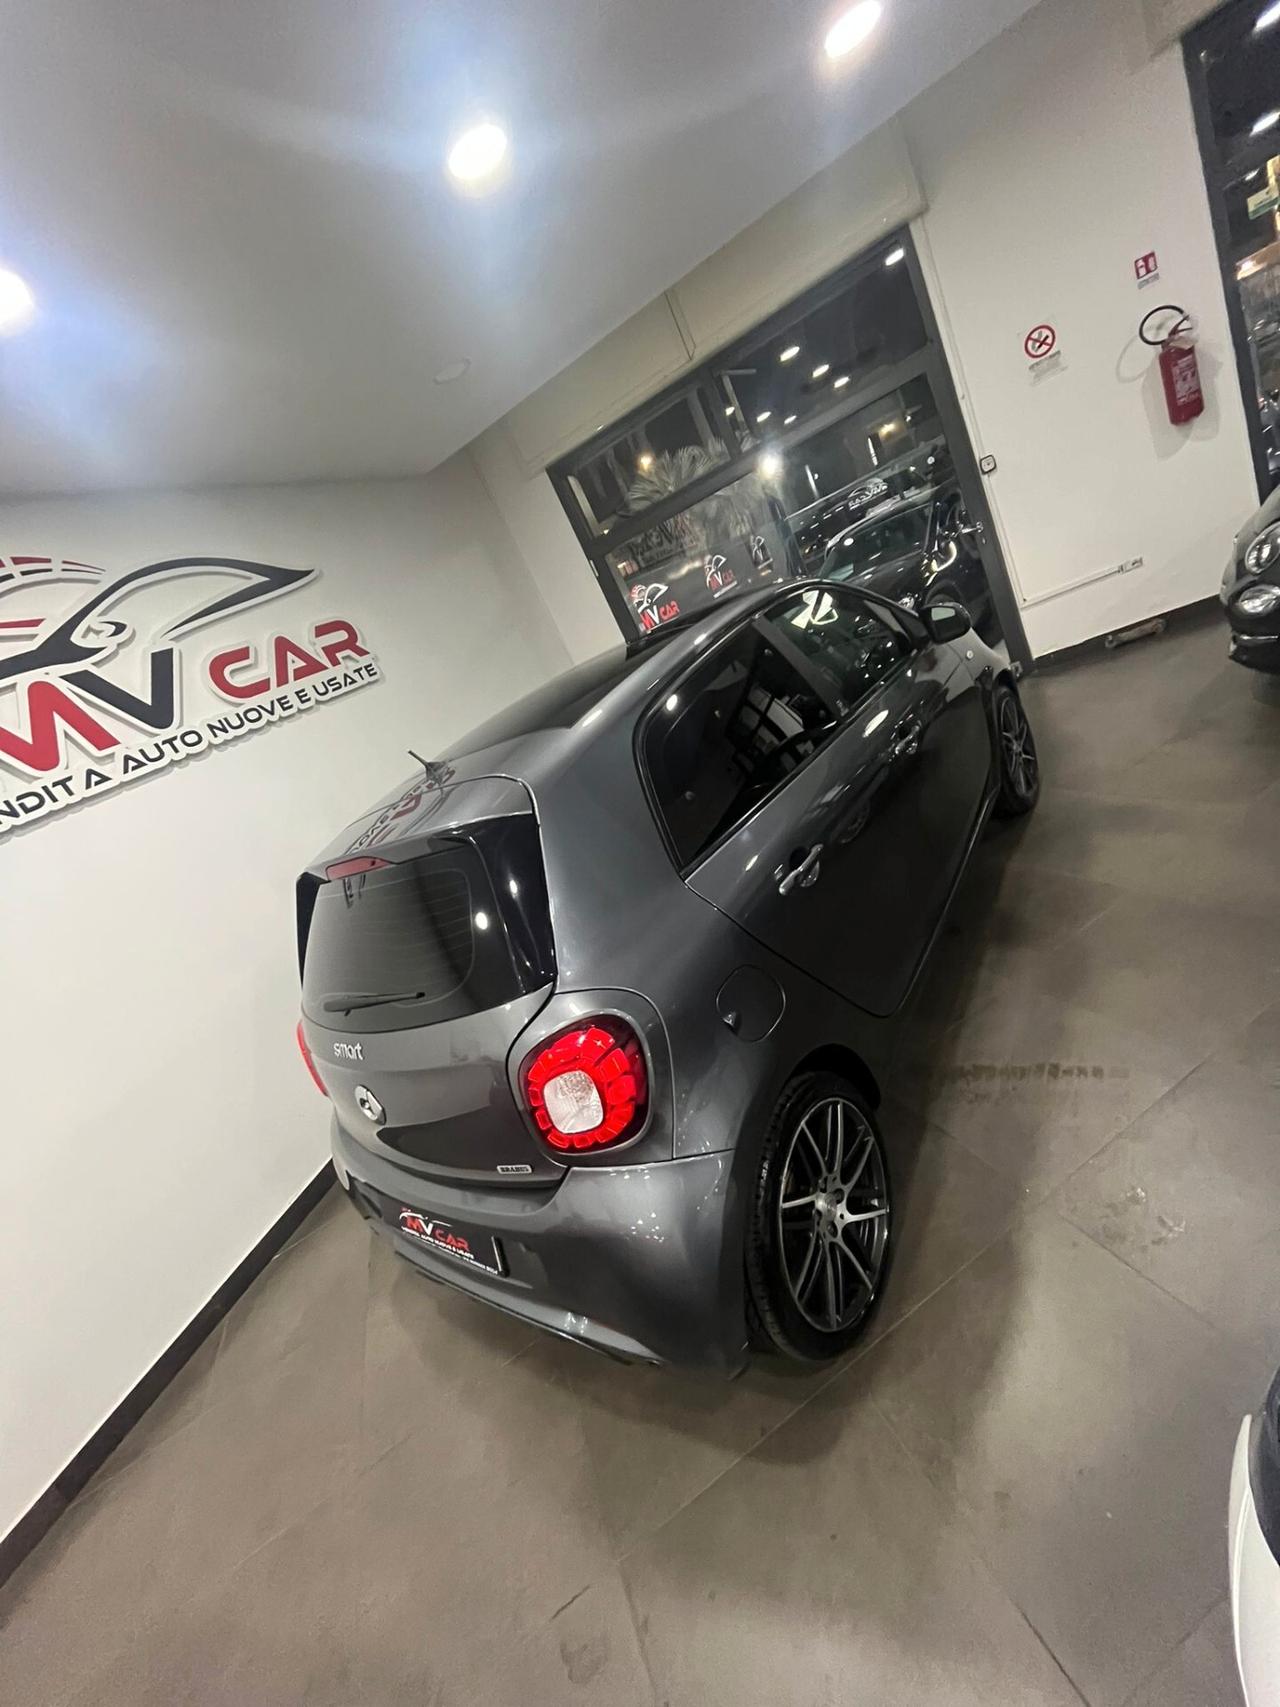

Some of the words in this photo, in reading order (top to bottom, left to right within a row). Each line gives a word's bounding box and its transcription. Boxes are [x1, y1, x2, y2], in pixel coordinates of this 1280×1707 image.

[659, 600, 680, 621] CAR
[209, 619, 371, 699] CAR
[123, 729, 203, 775] AUTO
[207, 695, 294, 739] NUOVE
[294, 688, 312, 704] E
[312, 663, 378, 698] USATE
[333, 1042, 363, 1060] smart
[434, 1229, 471, 1252] CAR
